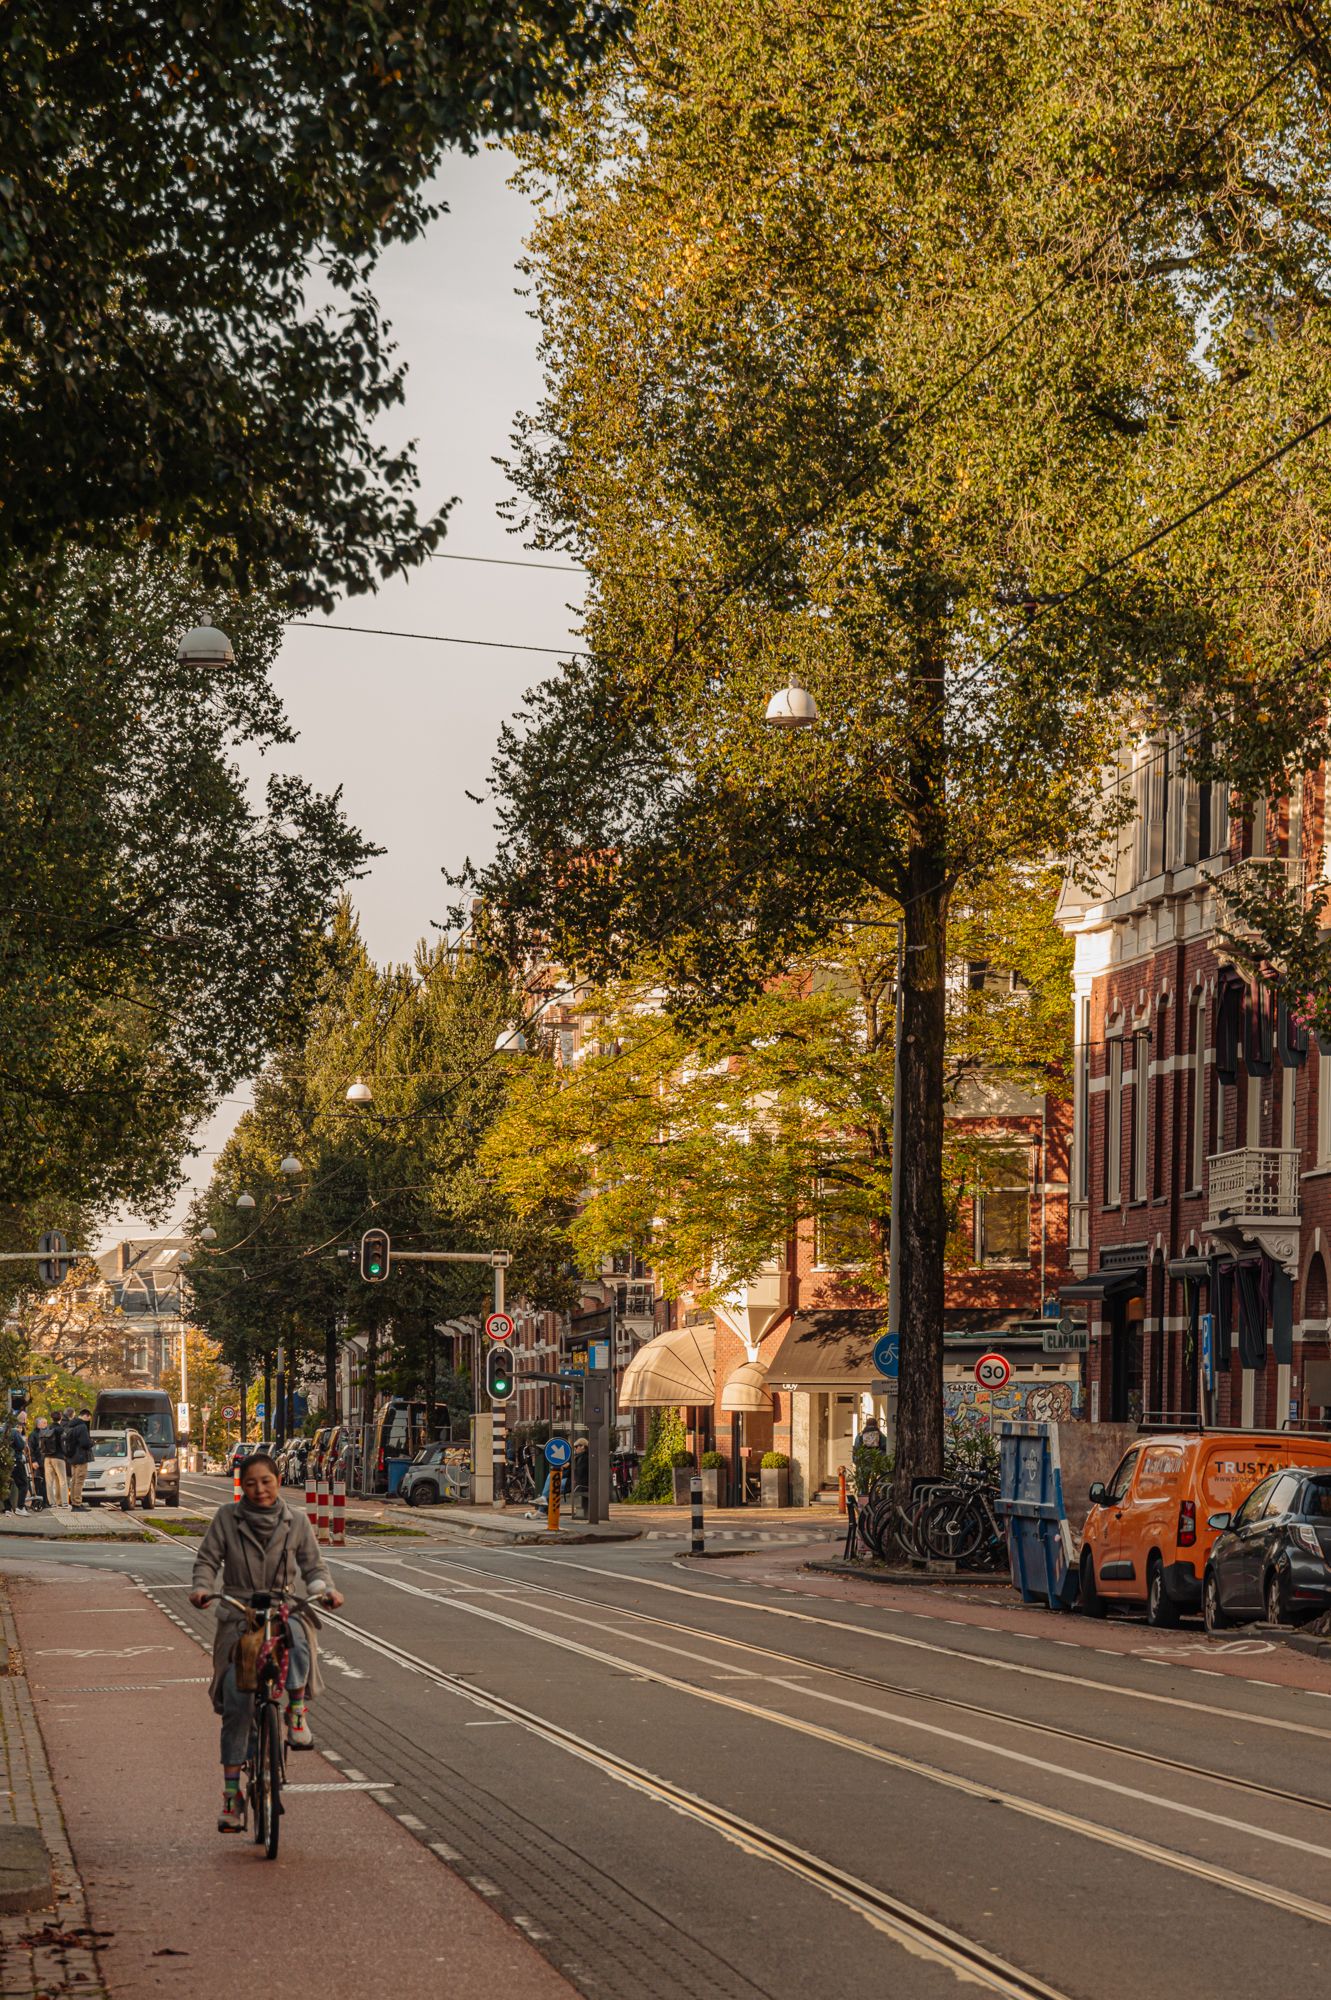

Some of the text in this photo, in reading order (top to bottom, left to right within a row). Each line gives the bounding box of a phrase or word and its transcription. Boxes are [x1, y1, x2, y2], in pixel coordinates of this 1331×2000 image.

[491, 1321, 508, 1332] 30
[1047, 1334, 1087, 1348] CLAPHAM
[982, 1365, 1005, 1379] 30
